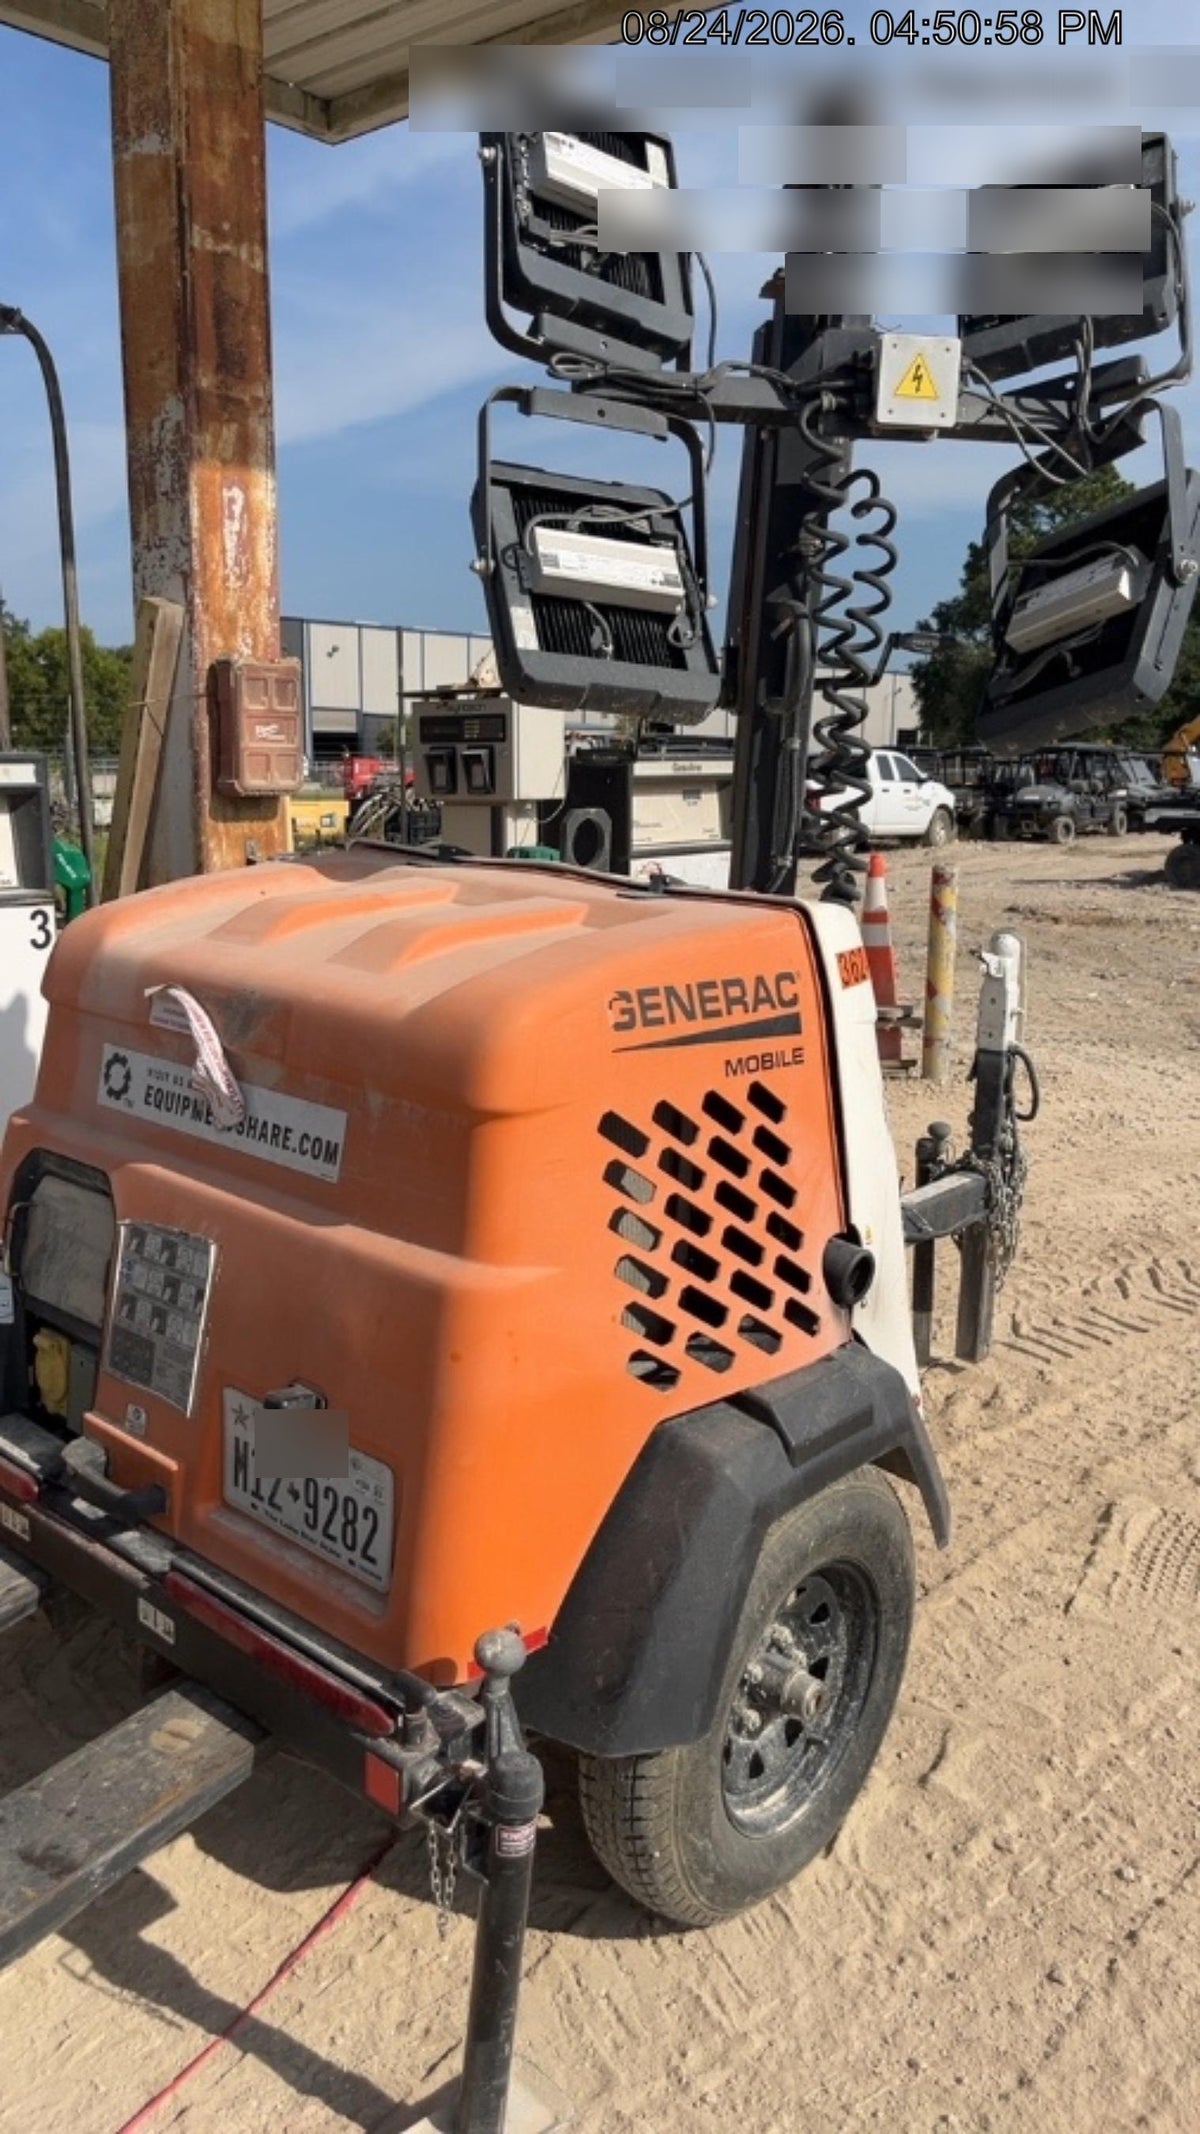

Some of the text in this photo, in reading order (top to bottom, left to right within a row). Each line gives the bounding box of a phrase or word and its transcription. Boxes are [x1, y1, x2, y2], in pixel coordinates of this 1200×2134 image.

[30, 909, 51, 949] 3
[608, 971, 799, 1032] GENERAC
[725, 1047, 805, 1077] MOBILE
[143, 1085, 340, 1165] EQUIPMESHARE.COM
